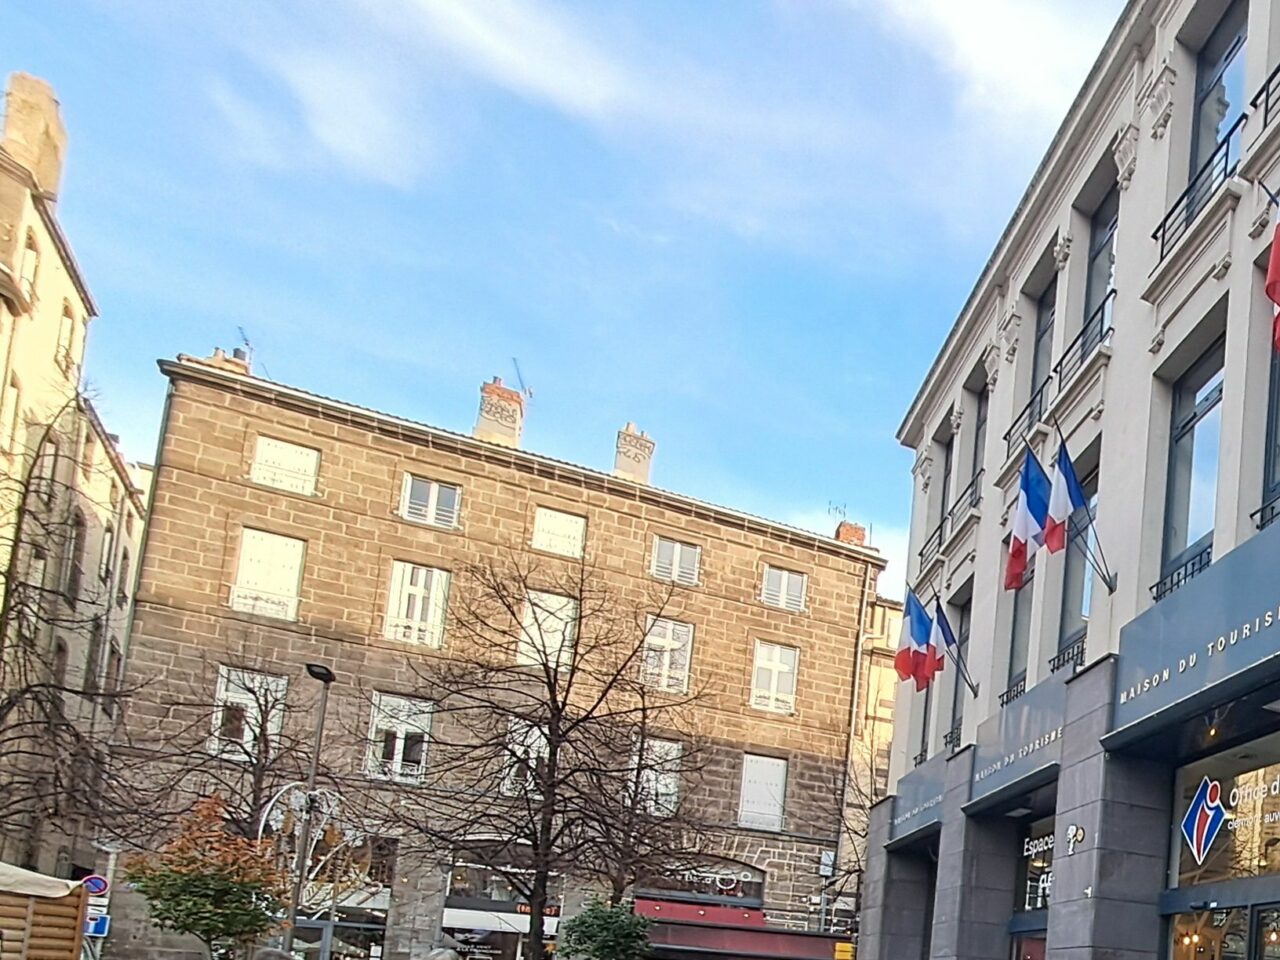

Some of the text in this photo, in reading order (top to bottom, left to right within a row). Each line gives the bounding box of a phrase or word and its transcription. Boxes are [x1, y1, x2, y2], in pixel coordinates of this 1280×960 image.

[1119, 667, 1171, 705] MAISON
[1178, 653, 1197, 674] DU
[1023, 834, 1056, 859] Espace
